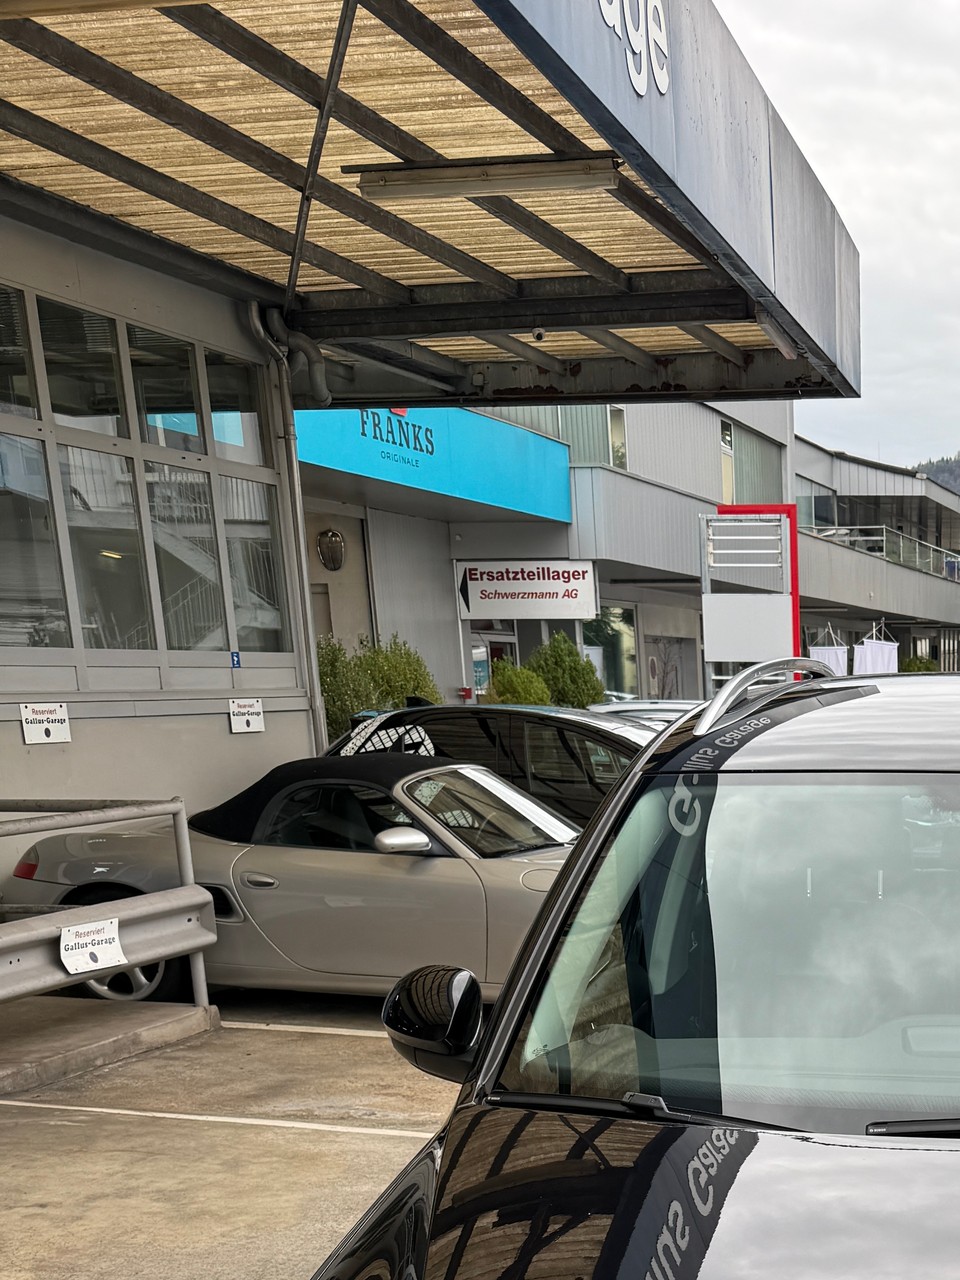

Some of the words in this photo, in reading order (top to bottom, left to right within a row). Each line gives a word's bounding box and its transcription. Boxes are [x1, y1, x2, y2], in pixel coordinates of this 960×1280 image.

[360, 409, 435, 456] FRANKS
[380, 450, 420, 468] ORIGINALE
[468, 566, 588, 583] Ersatzteillager
[480, 589, 558, 600] Schwerzmann
[562, 588, 578, 599] AG
[31, 707, 57, 716] Reserviert
[24, 717, 66, 725] Gallus-Garage
[74, 926, 105, 940] Reserviert
[64, 936, 116, 952] Gallus-Garage
